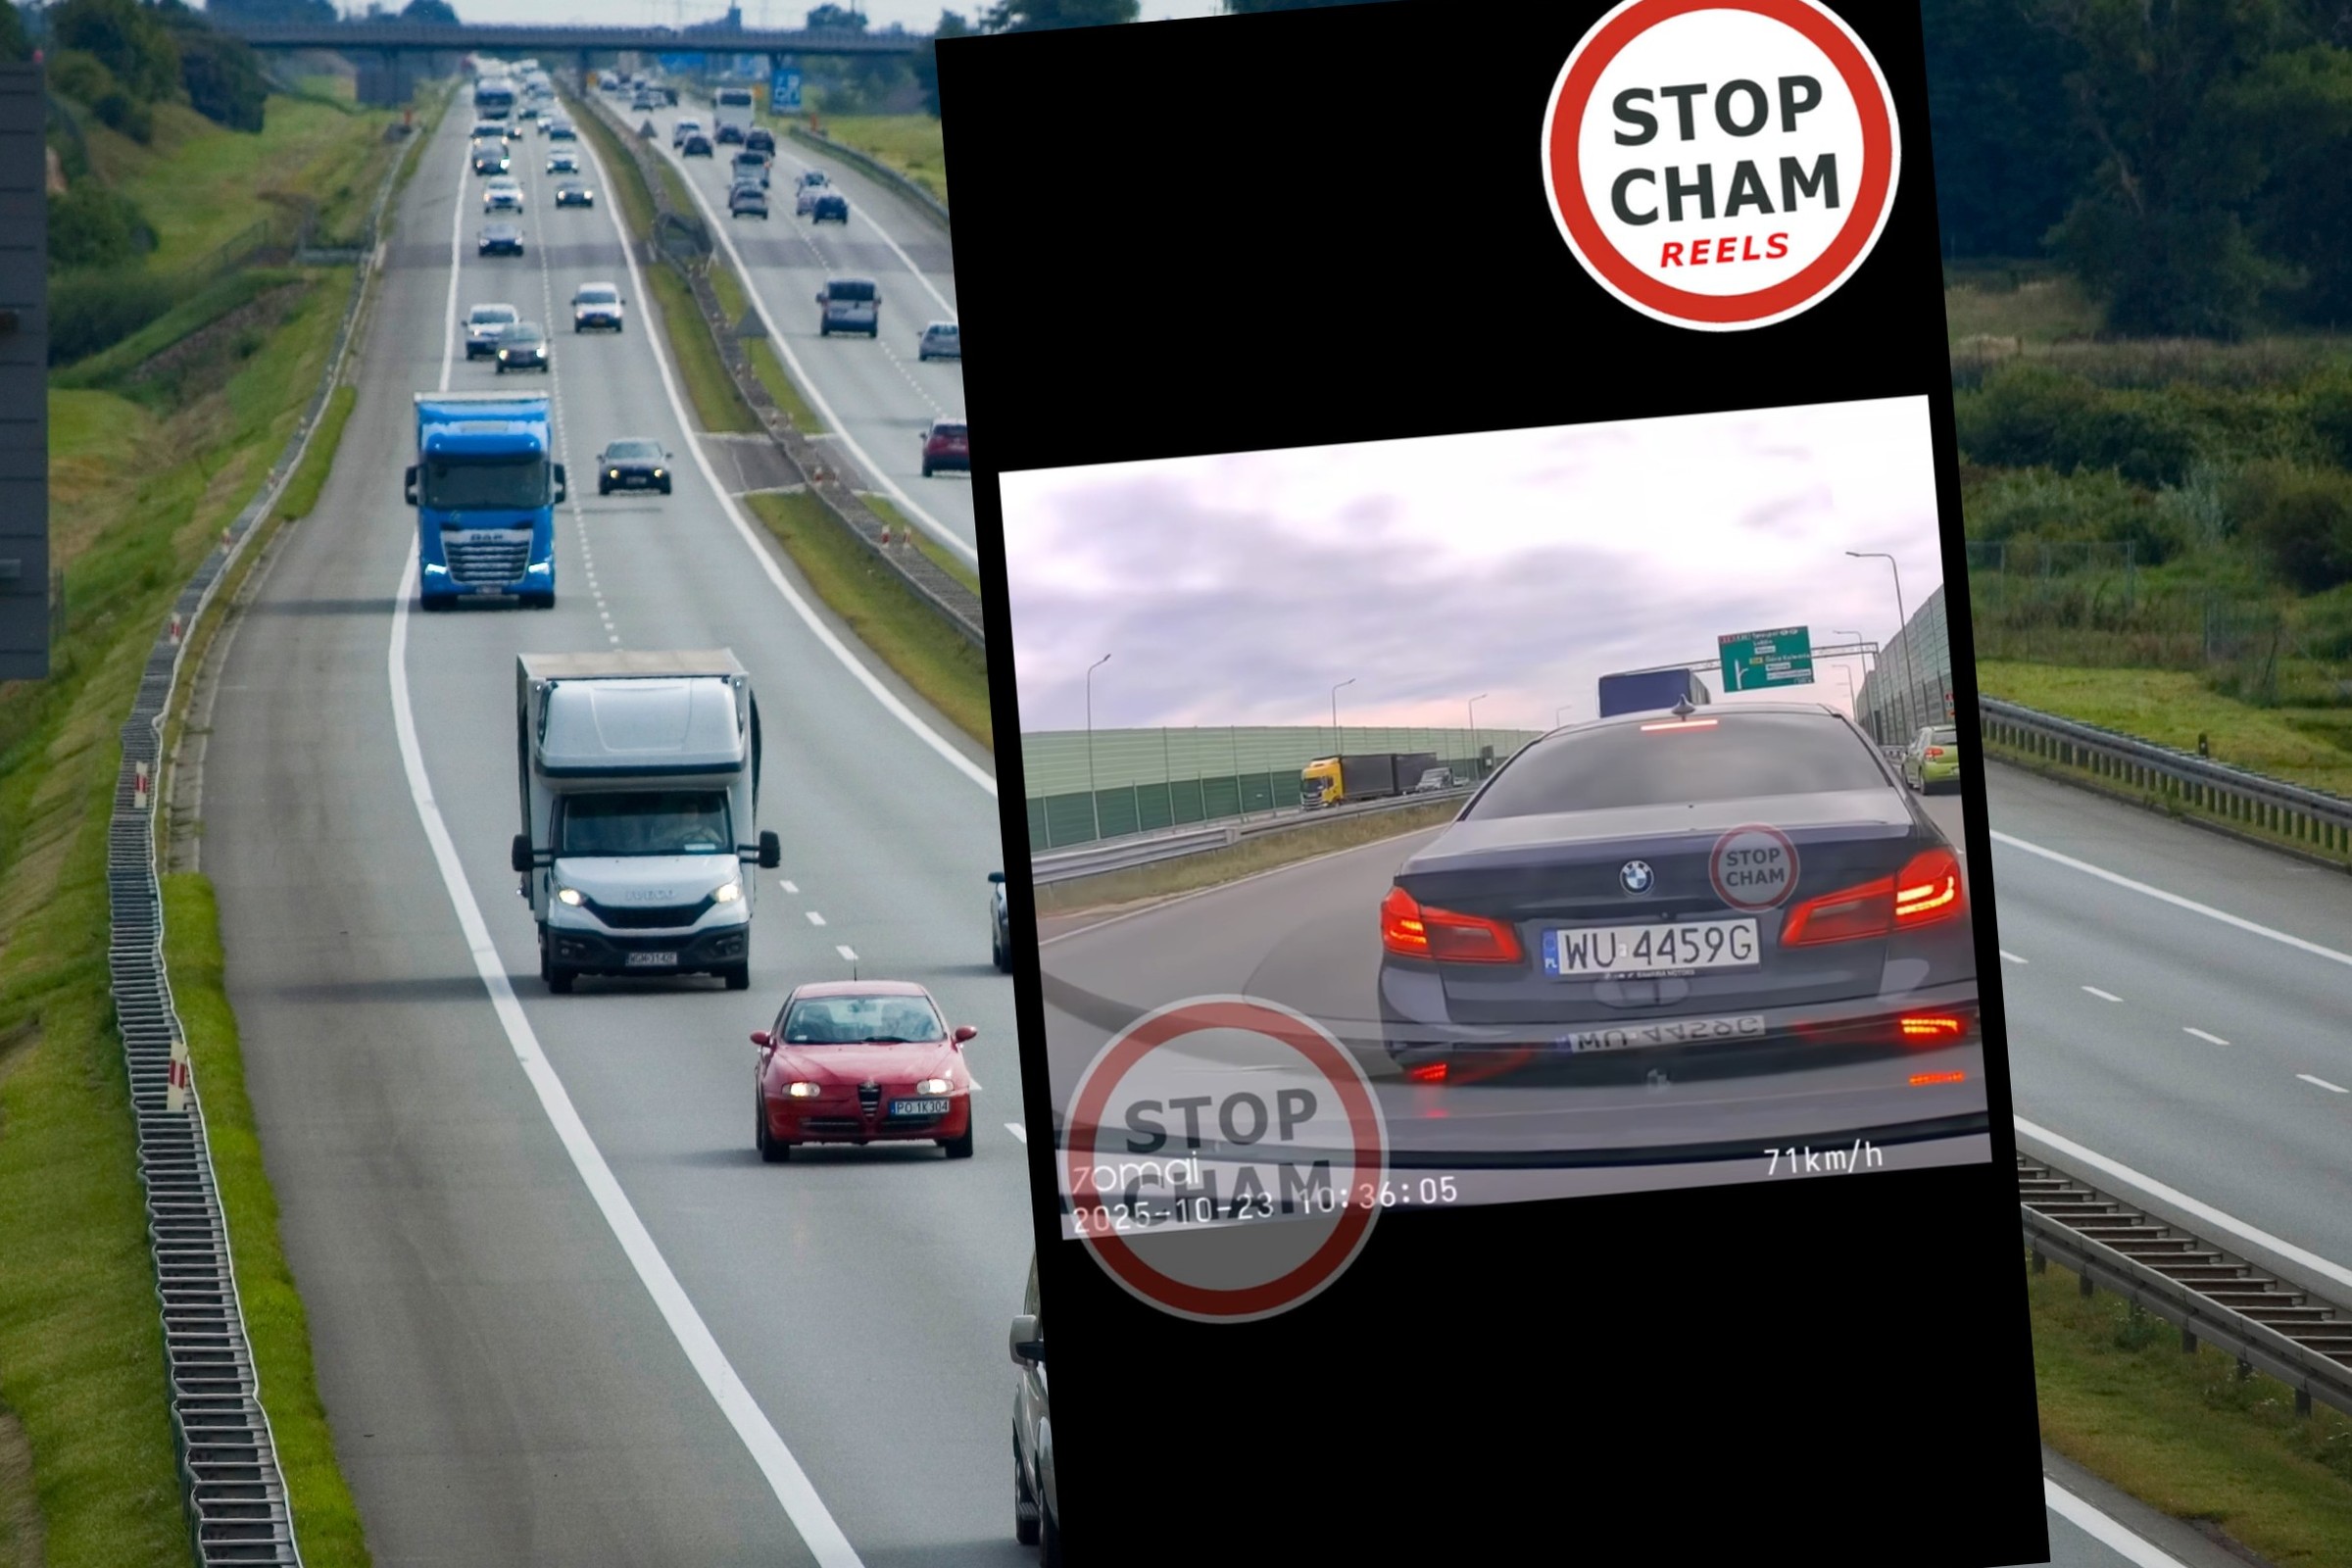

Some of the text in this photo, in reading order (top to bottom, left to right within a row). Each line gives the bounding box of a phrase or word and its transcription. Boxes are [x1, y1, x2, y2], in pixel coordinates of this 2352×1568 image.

[1565, 924, 1752, 970] WU 4459G
[1544, 957, 1558, 969] PL
[897, 1102, 912, 1113] PO
